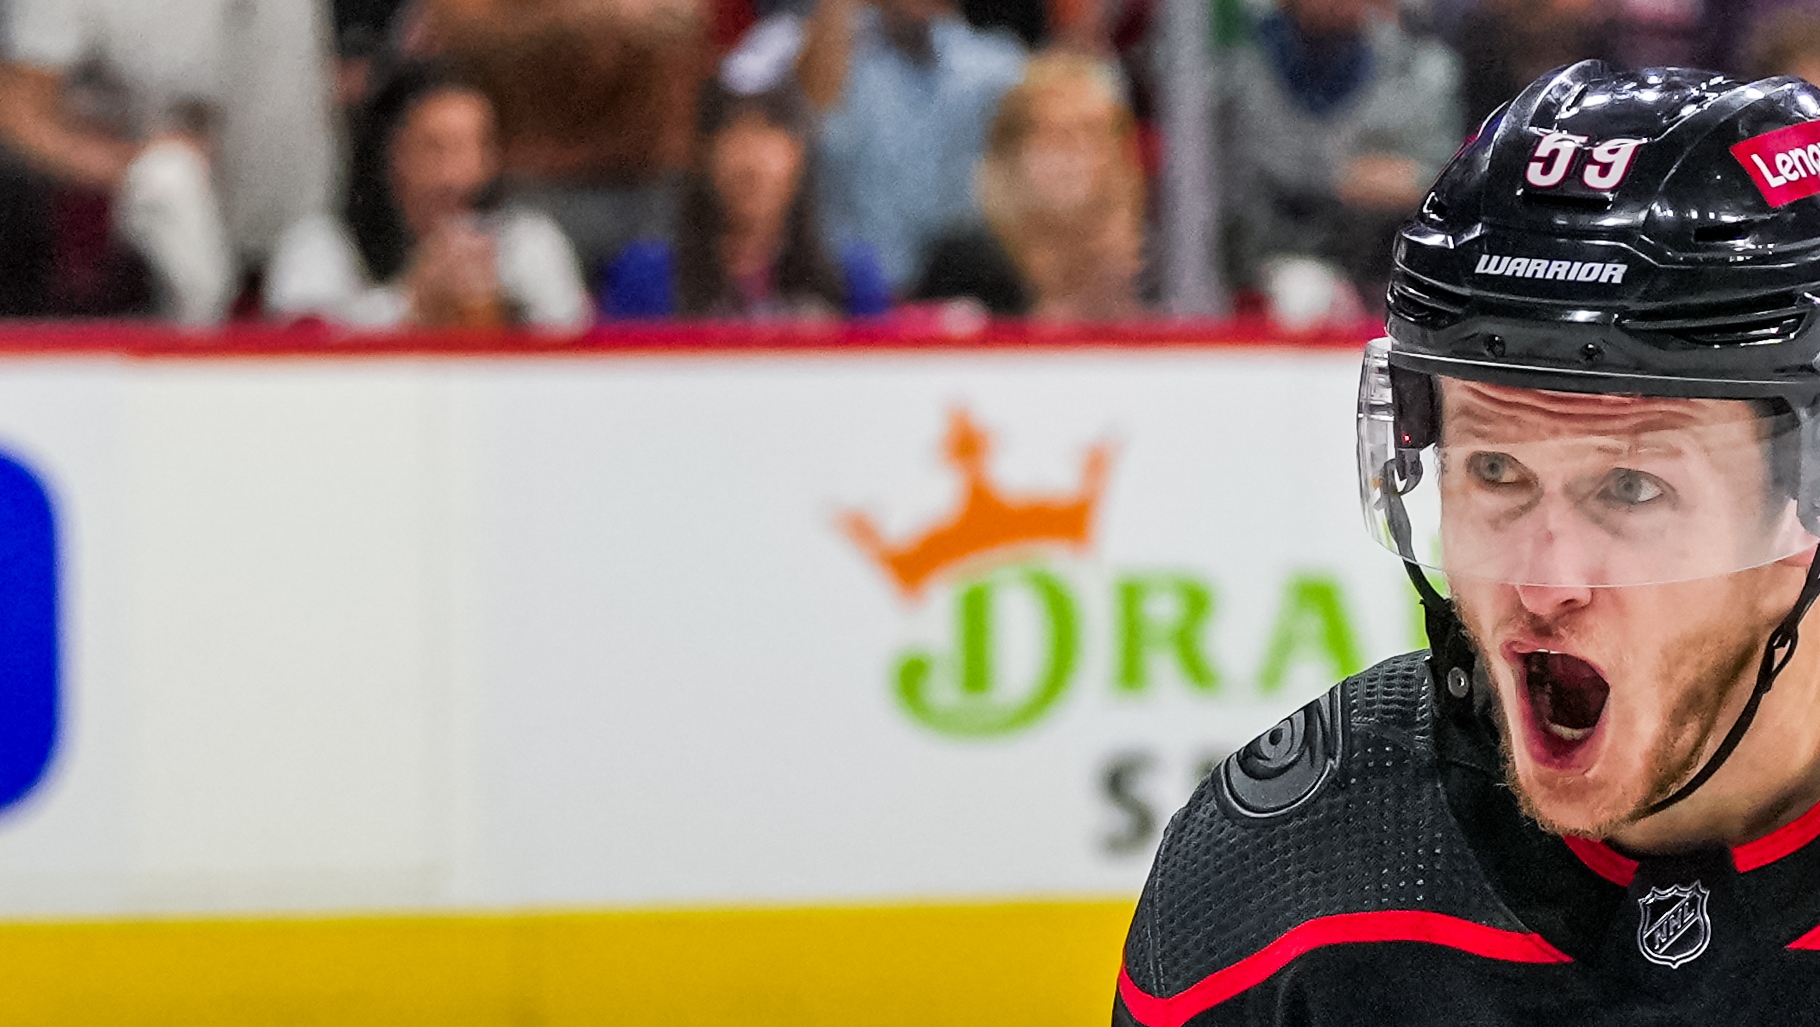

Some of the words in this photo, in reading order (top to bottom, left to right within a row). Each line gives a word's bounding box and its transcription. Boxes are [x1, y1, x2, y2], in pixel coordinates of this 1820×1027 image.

[1526, 132, 1641, 190] 59
[1474, 254, 1628, 284] WARRIOR
[1653, 901, 1695, 950] NHL
